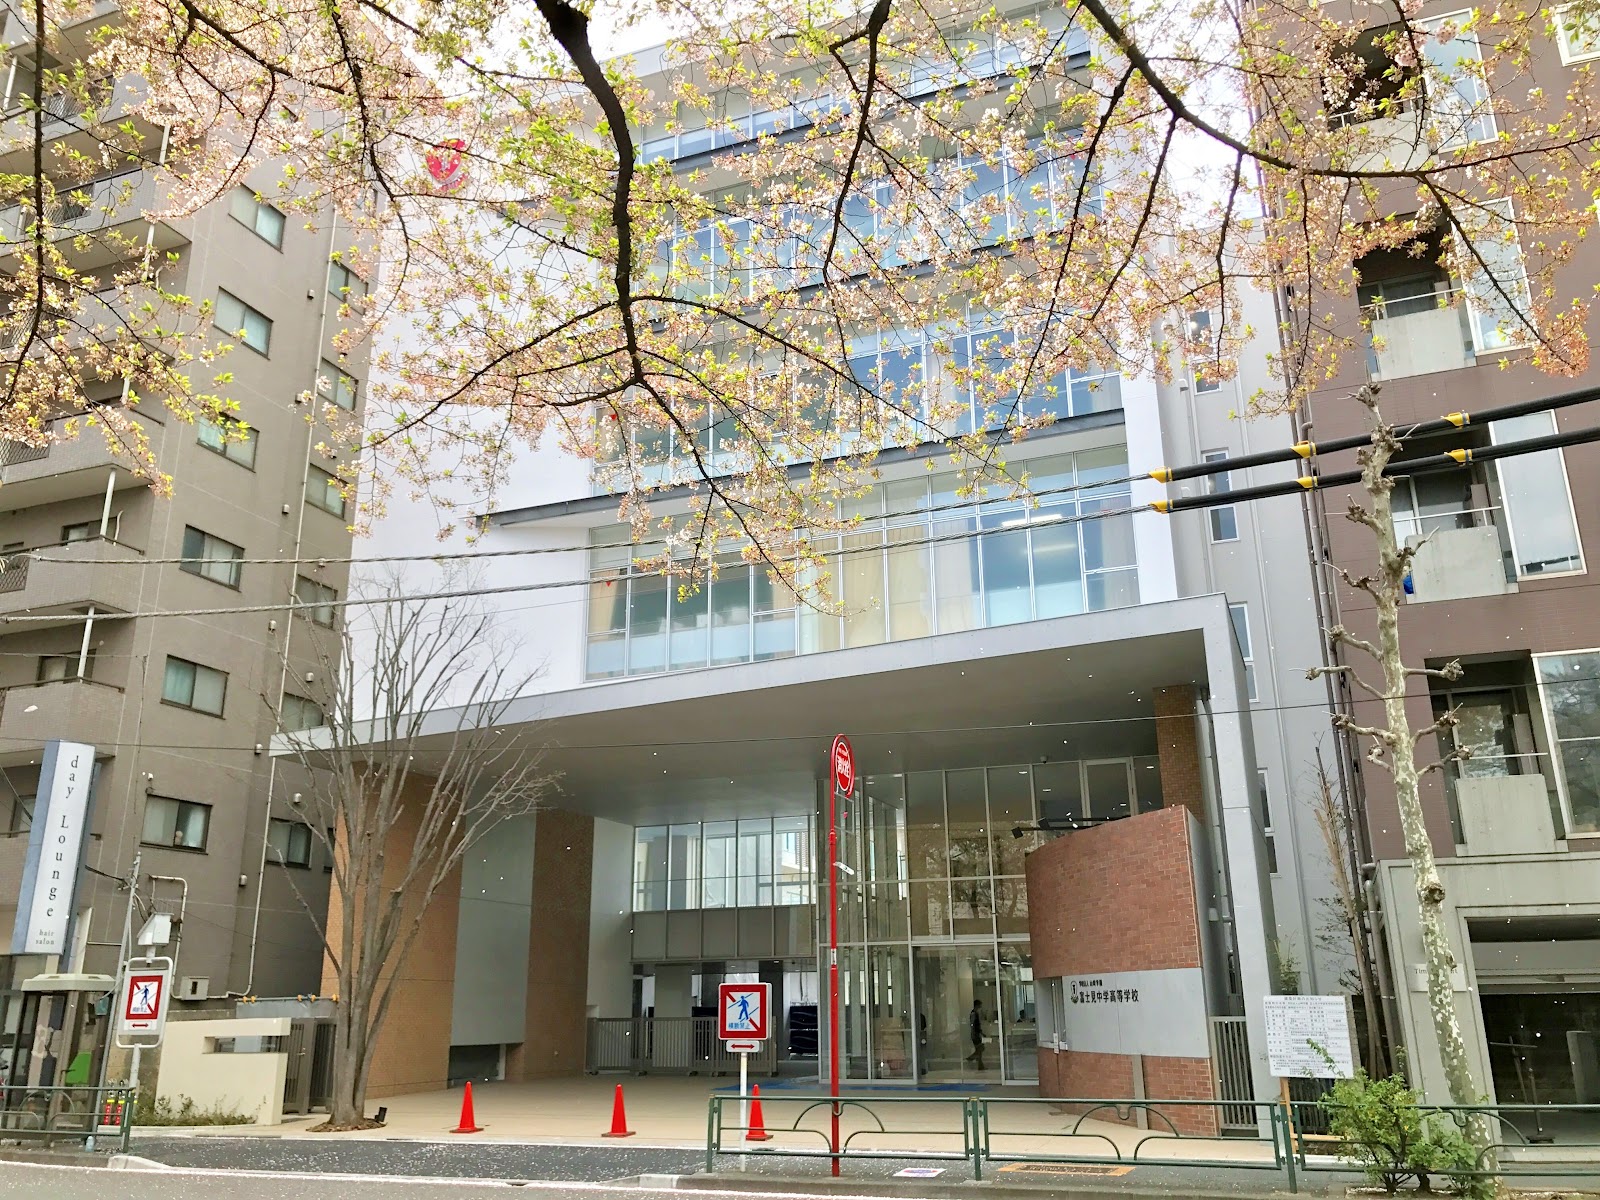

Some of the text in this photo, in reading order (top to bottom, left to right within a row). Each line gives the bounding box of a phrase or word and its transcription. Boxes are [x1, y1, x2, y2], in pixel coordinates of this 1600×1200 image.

[46, 755, 79, 917] day Lounge
[39, 929, 55, 937] hair
[1079, 989, 1139, 1004] 富士見中学高等学校
